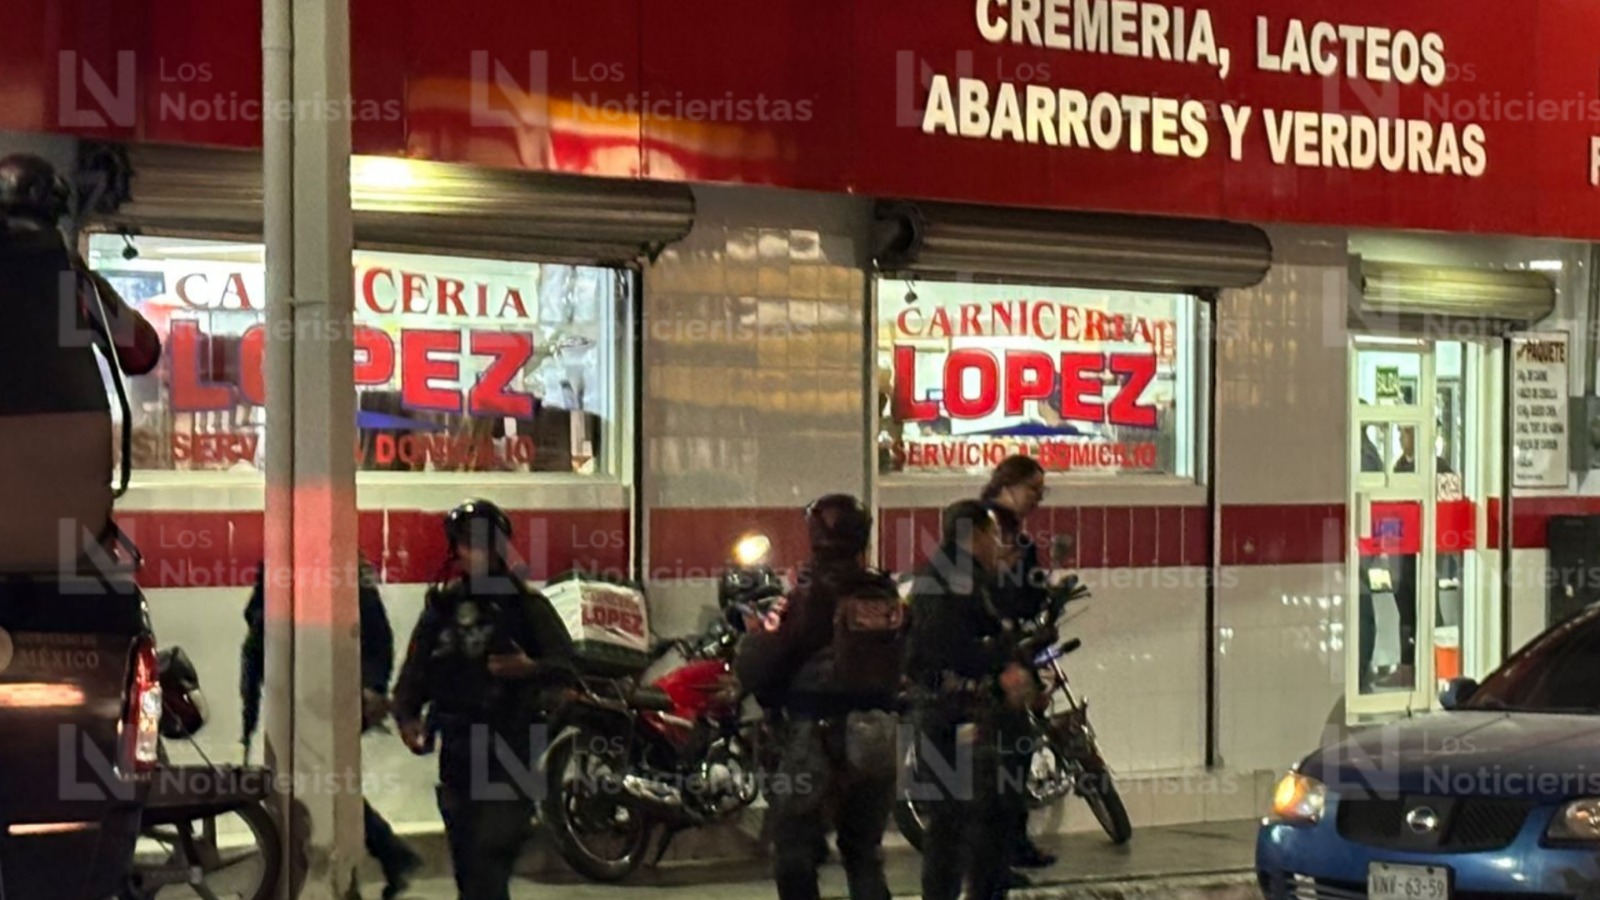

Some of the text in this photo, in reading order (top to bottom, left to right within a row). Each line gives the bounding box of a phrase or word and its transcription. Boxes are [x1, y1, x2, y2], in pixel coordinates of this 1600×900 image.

[976, 0, 1446, 88] CREMERIA, LACTEOS
[921, 75, 1209, 159] ABARROTES
[1220, 104, 1252, 161] Y
[1263, 108, 1488, 177] VERDURAS
[174, 266, 531, 319] CACERIA
[896, 298, 1154, 343] CARNICERIA
[893, 344, 1157, 429] LOPEZ
[580, 603, 645, 639] LOPEZ
